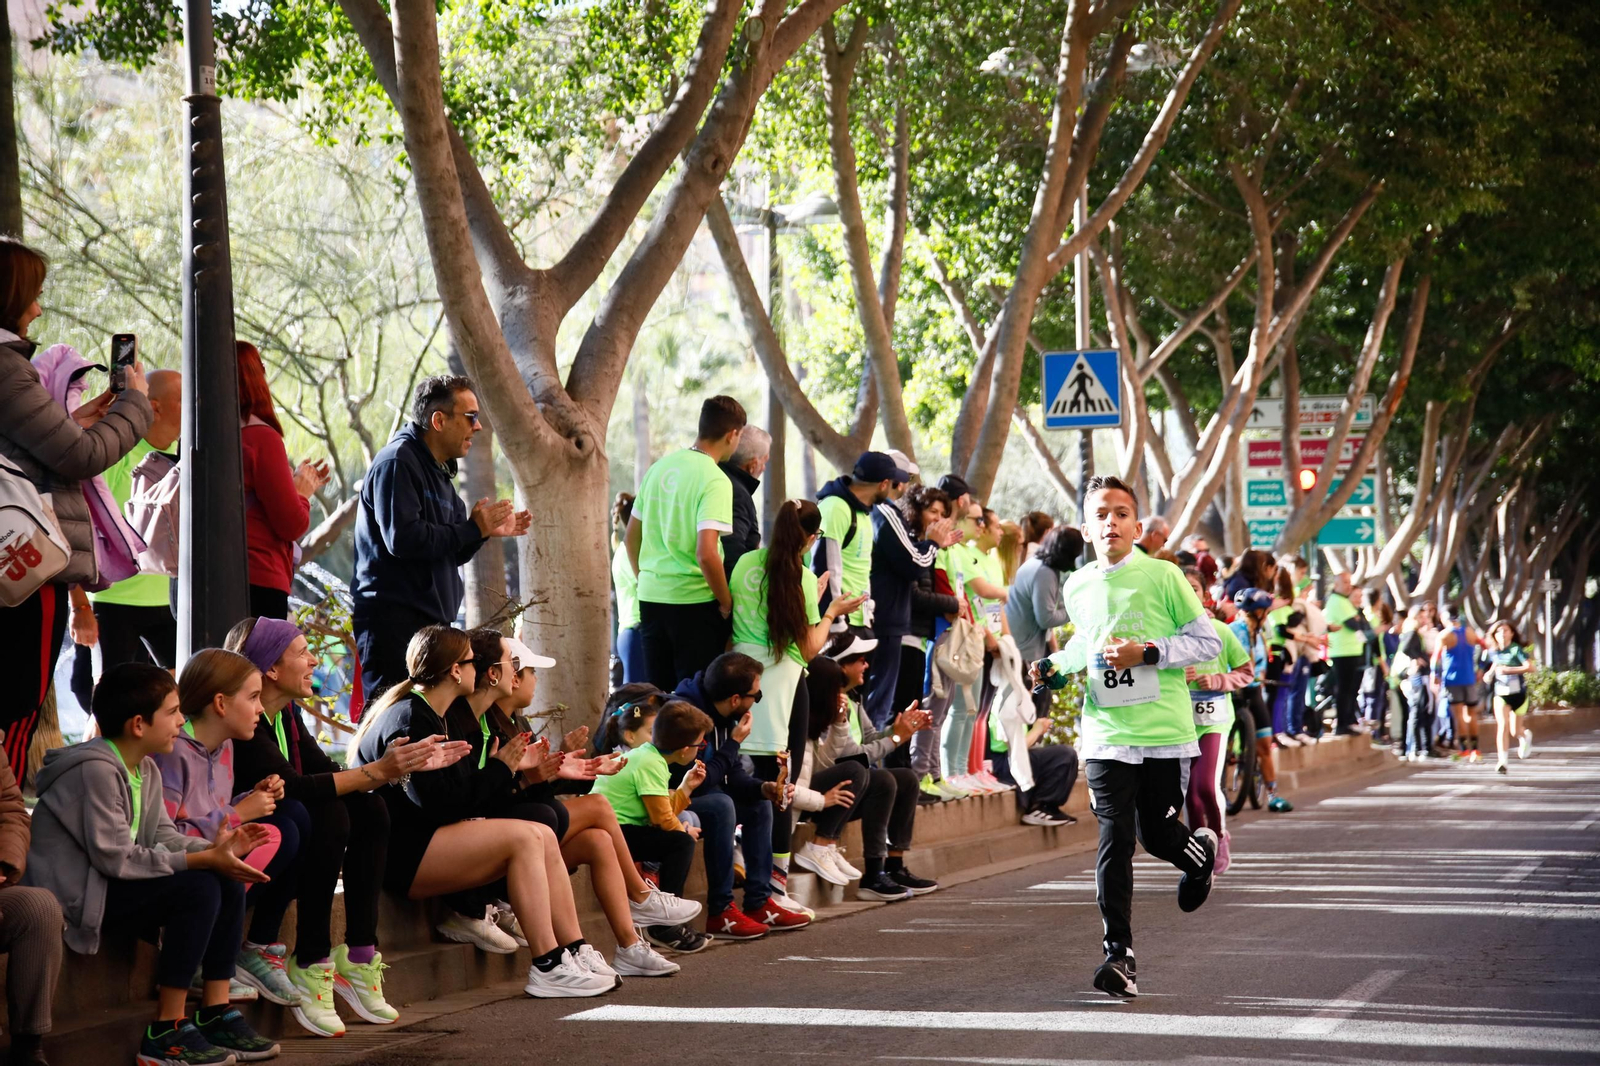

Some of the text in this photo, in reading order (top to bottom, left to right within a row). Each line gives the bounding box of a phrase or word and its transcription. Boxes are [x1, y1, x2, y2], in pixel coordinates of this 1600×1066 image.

[1132, 620, 1144, 631] el
[1104, 669, 1134, 688] 84
[1195, 702, 1215, 714] 65
